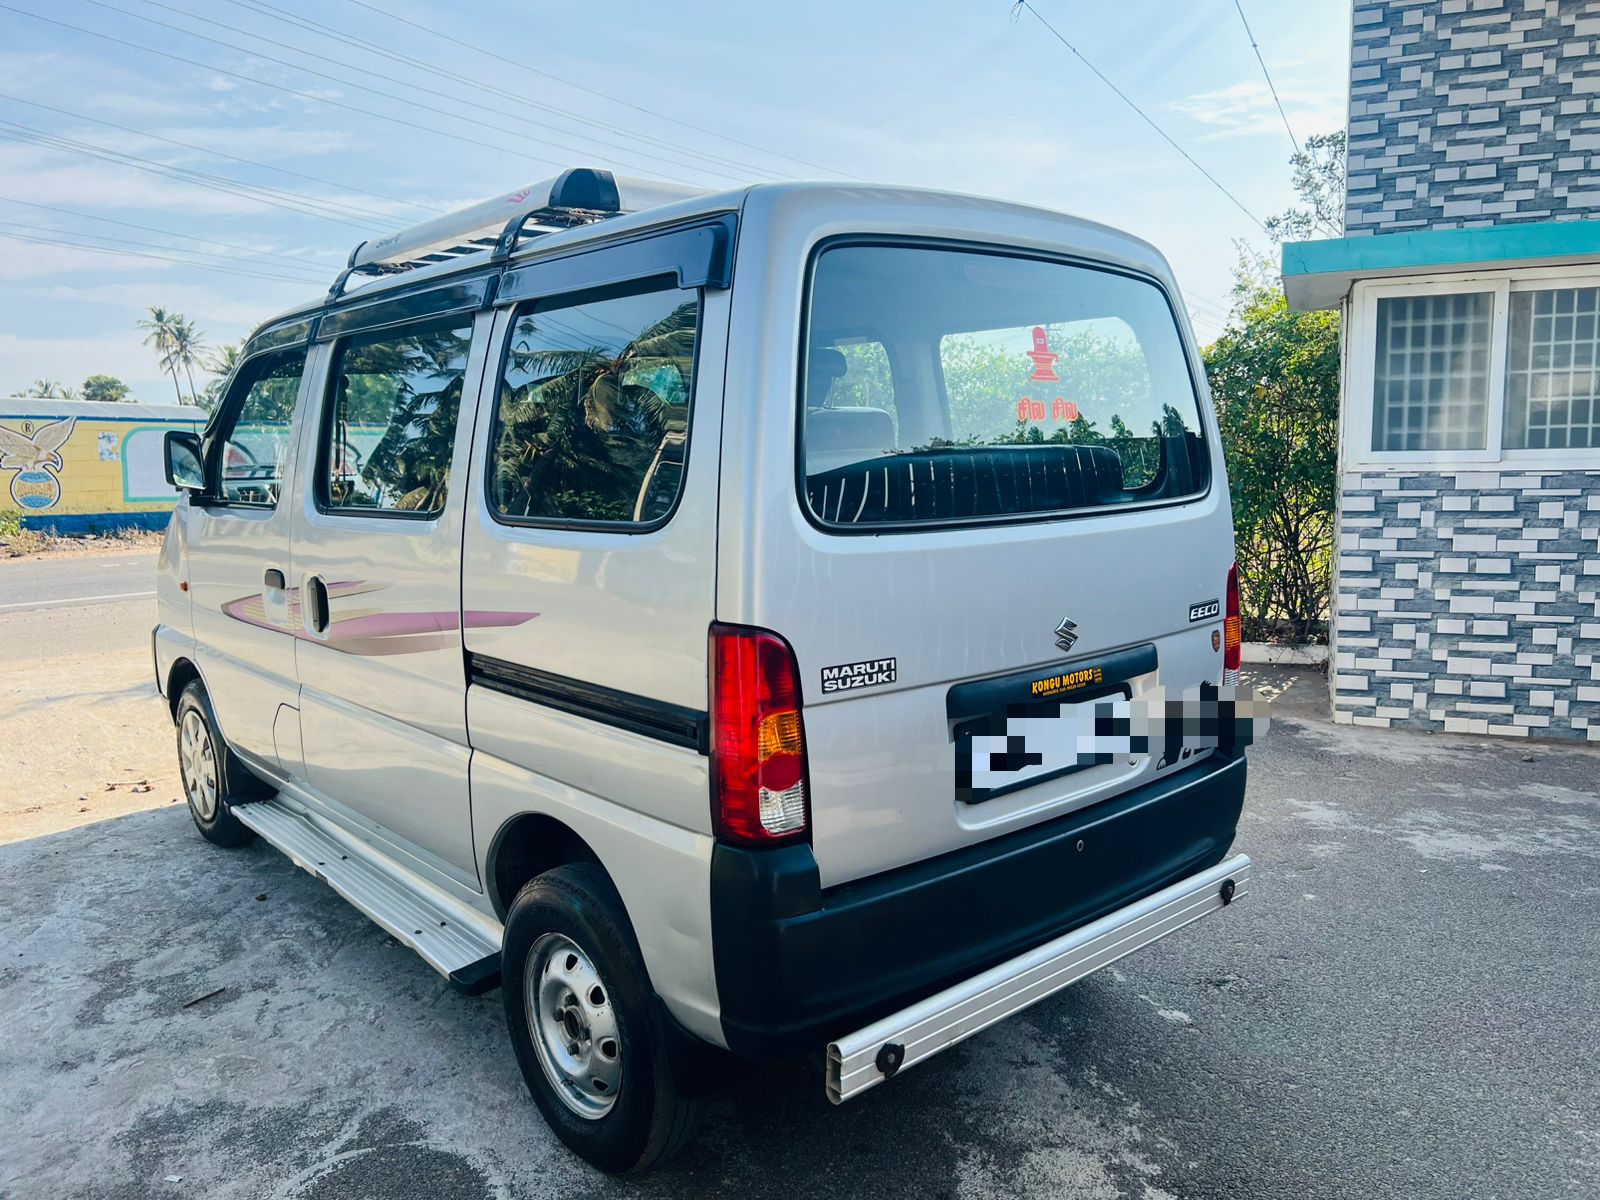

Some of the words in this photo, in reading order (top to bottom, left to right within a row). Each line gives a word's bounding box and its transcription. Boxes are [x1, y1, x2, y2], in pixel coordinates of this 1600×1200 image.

[1190, 603, 1219, 620] EECO
[823, 659, 896, 680] MARUTI
[824, 670, 896, 692] SUZUKI
[1032, 676, 1061, 694] KONGU
[1062, 669, 1093, 686] MOTORS
